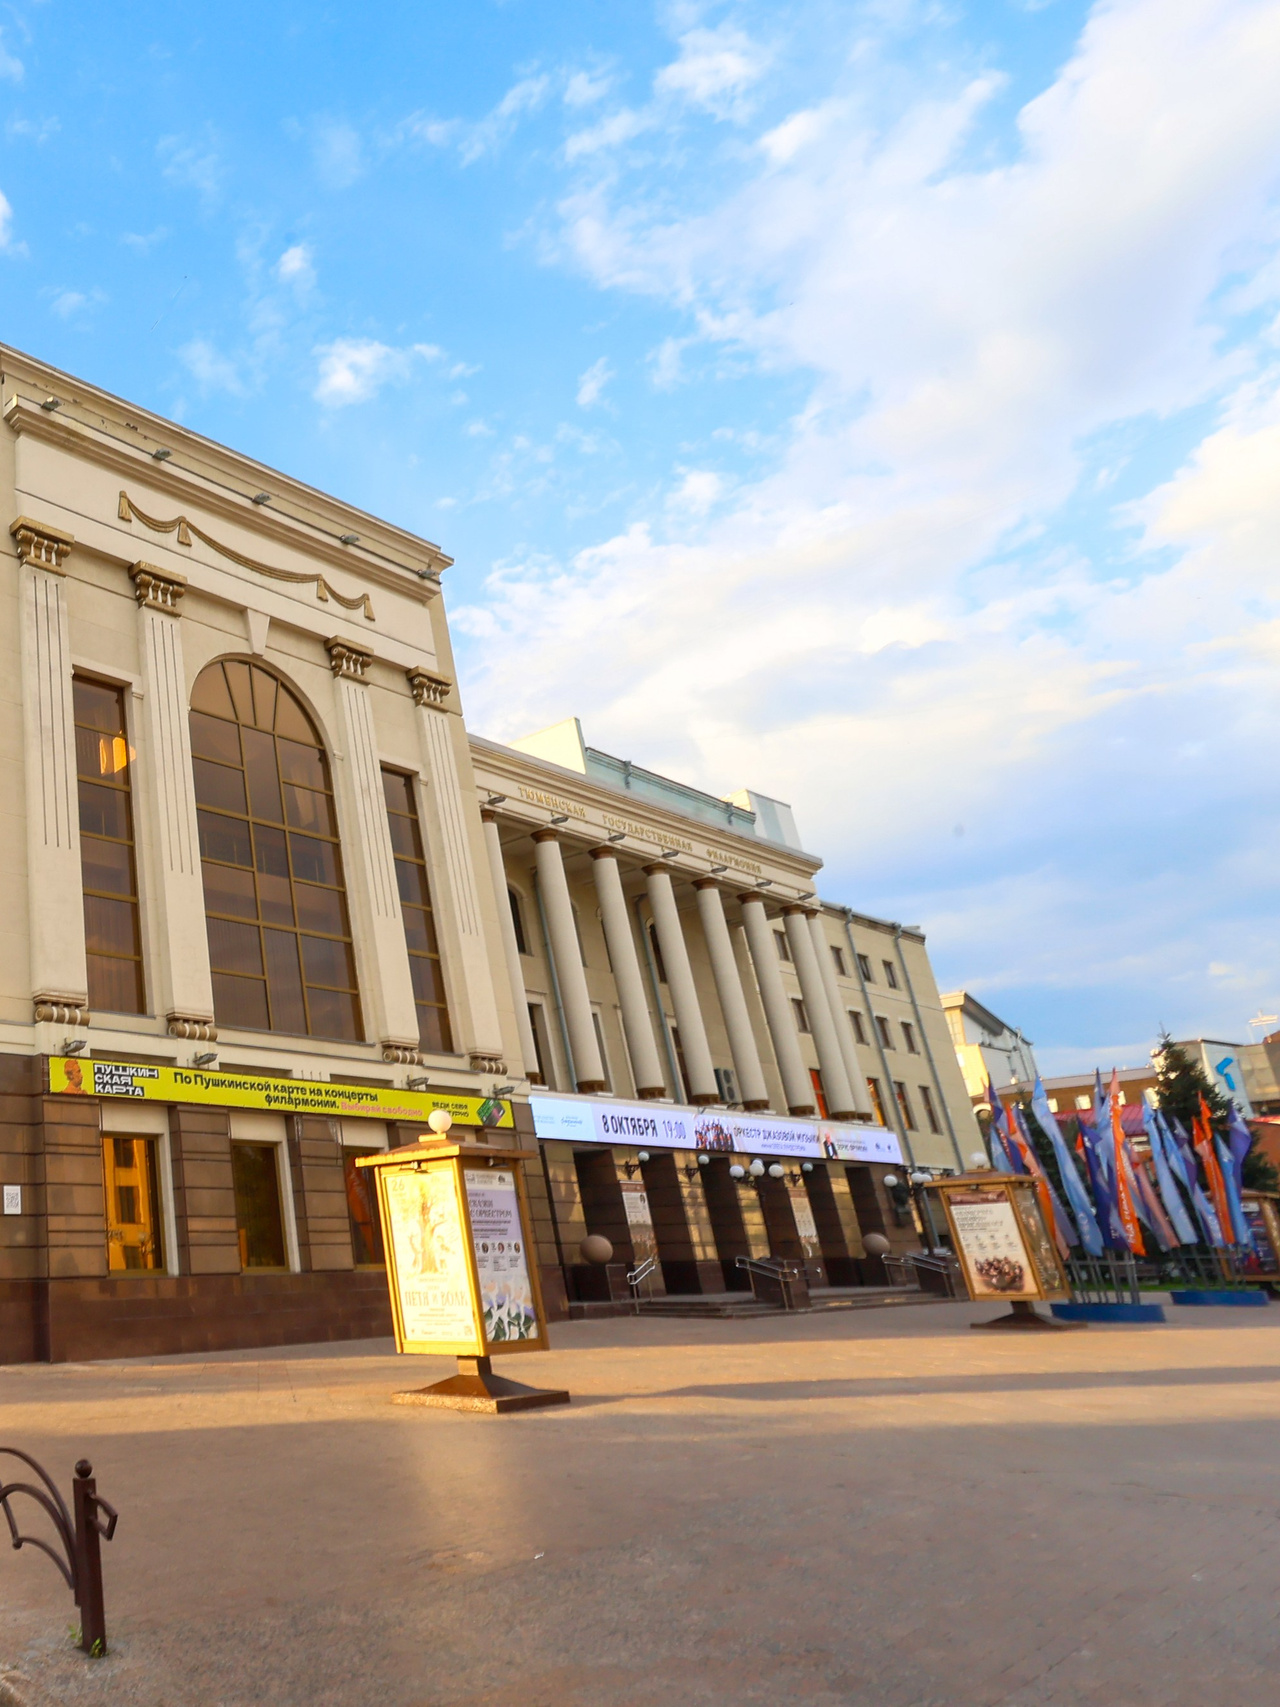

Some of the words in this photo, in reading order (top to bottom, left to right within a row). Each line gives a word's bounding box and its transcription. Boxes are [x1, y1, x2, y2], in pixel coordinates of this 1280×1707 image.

[517, 785, 587, 819] ТЮМЕНСКАЯ
[602, 813, 693, 853] ГОСУДАРСТВЕННАЯ
[706, 848, 762, 874] ФИЛАРМОНИЯ
[94, 1064, 159, 1079] ПУШКИН
[94, 1074, 133, 1086] СКАЯ
[95, 1084, 145, 1096] КАРТА
[173, 1071, 192, 1085] По
[194, 1074, 271, 1092] Пушкинской
[272, 1083, 307, 1099] карте
[309, 1088, 323, 1098] на
[325, 1089, 379, 1104] концерты
[265, 1093, 340, 1110] филармонии.
[341, 1101, 382, 1114] Выбирай
[382, 1104, 423, 1117] свободно
[601, 1114, 610, 1134] 8
[611, 1115, 658, 1138] ОКТЯБРЯ
[662, 1120, 687, 1140] 19:00
[733, 1125, 762, 1140] ОРКЕСТР
[762, 1127, 795, 1143] ДЖАЗОВОЙ
[795, 1131, 820, 1145] МУЗЫКИ
[392, 1181, 404, 1191] 26
[405, 1291, 430, 1307] ПЕТЯ
[440, 1291, 468, 1307] ВОЛК
